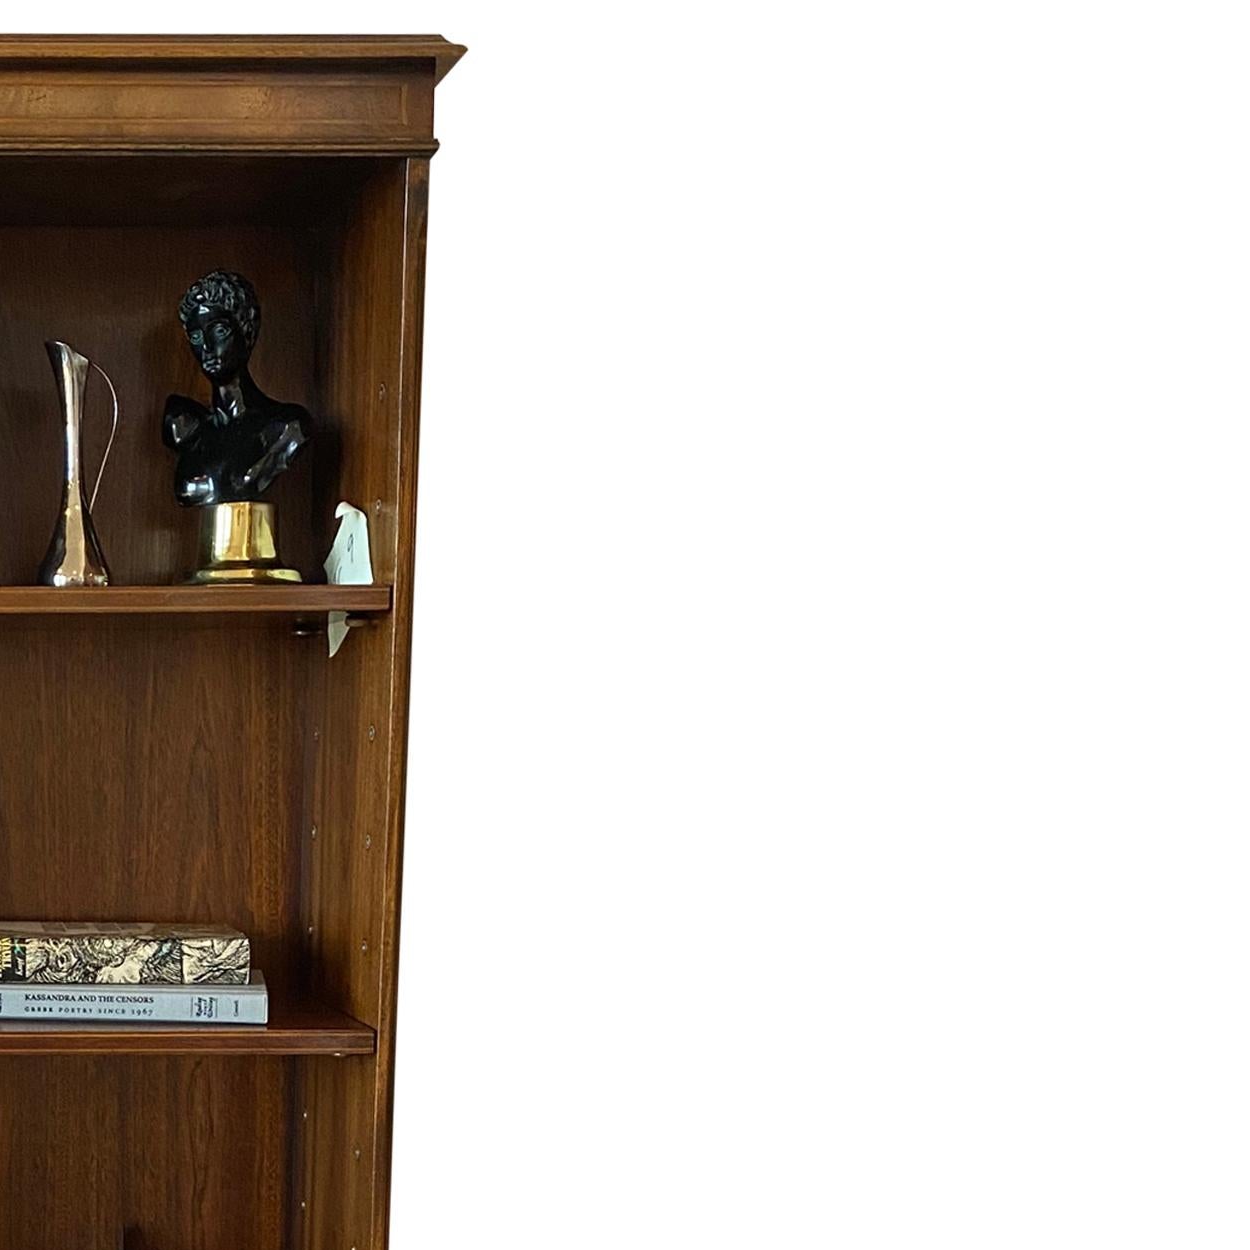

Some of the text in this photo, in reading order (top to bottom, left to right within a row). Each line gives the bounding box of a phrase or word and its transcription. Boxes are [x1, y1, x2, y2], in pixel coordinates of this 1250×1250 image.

[24, 993, 155, 1004] KASSANDRA AND THE CENSORS
